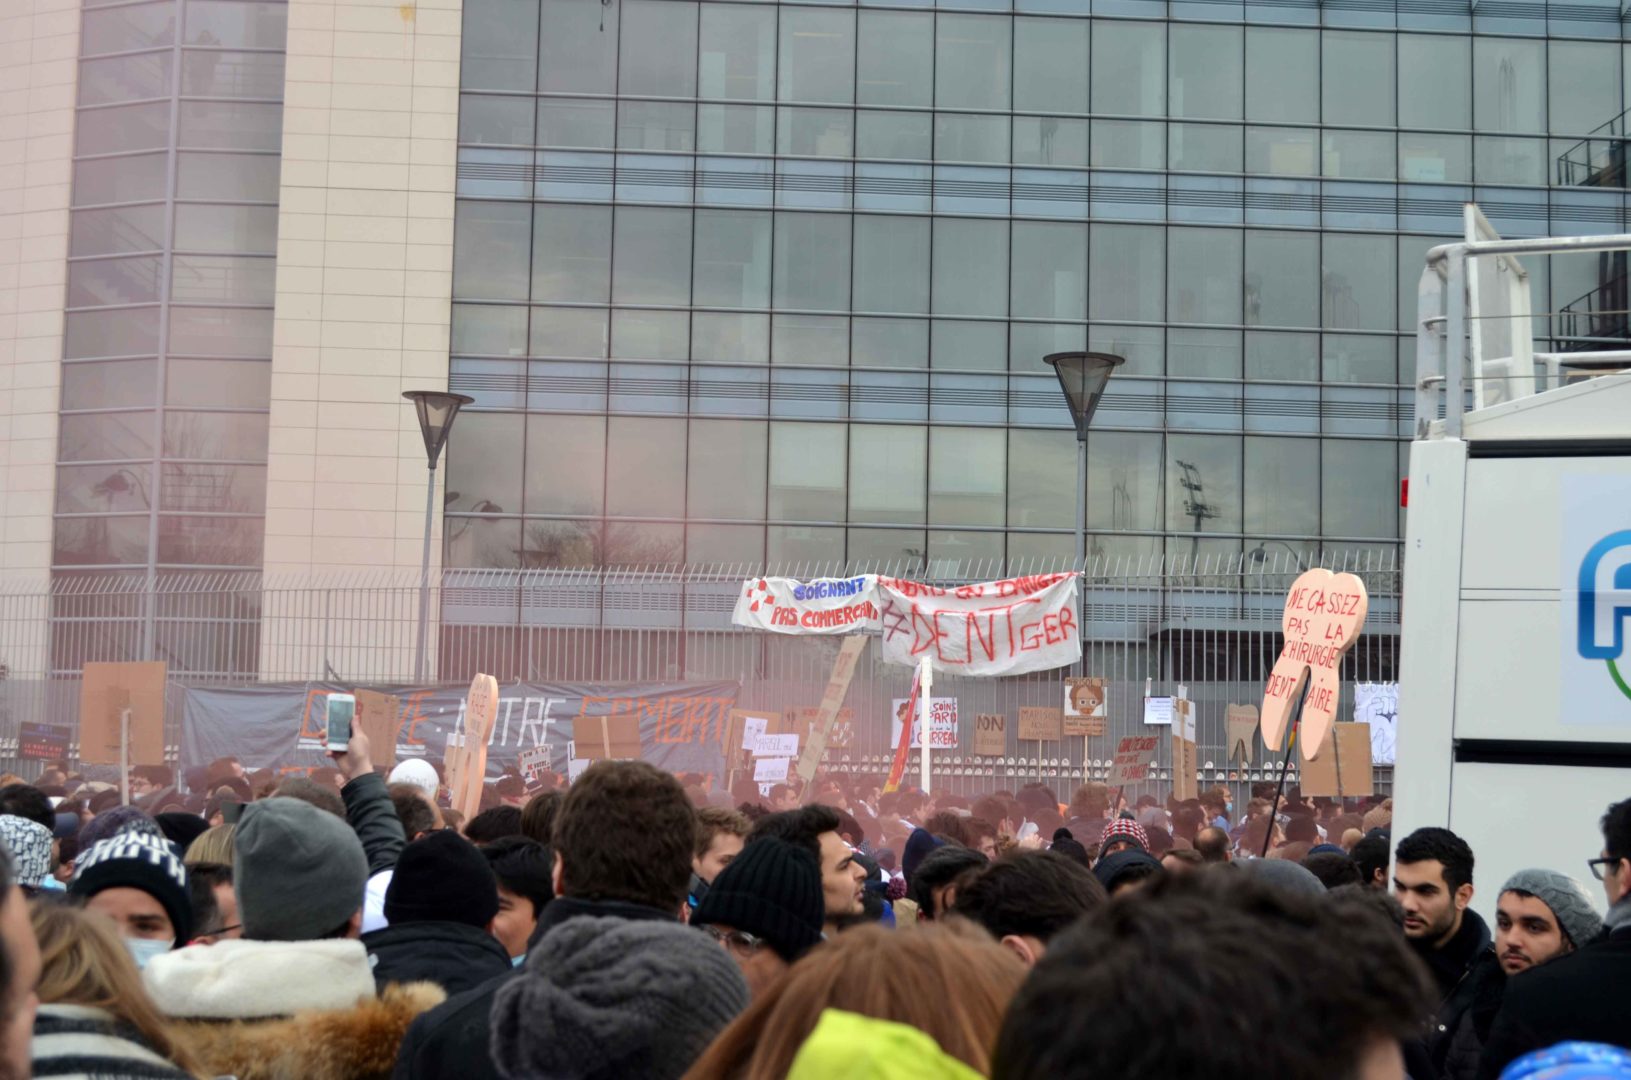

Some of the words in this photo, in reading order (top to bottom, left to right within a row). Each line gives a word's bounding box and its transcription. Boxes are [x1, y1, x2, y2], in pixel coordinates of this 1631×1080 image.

[794, 577, 866, 601] SOIGNANT
[1287, 587, 1308, 610] NE
[1308, 586, 1360, 616] CASSEZ
[770, 606, 798, 626] PAS
[1287, 617, 1309, 636] PAS
[1325, 623, 1344, 641] LA
[1282, 638, 1340, 669] CHIRURGIE
[454, 697, 566, 747] TRE
[917, 731, 958, 745] CRREAU
